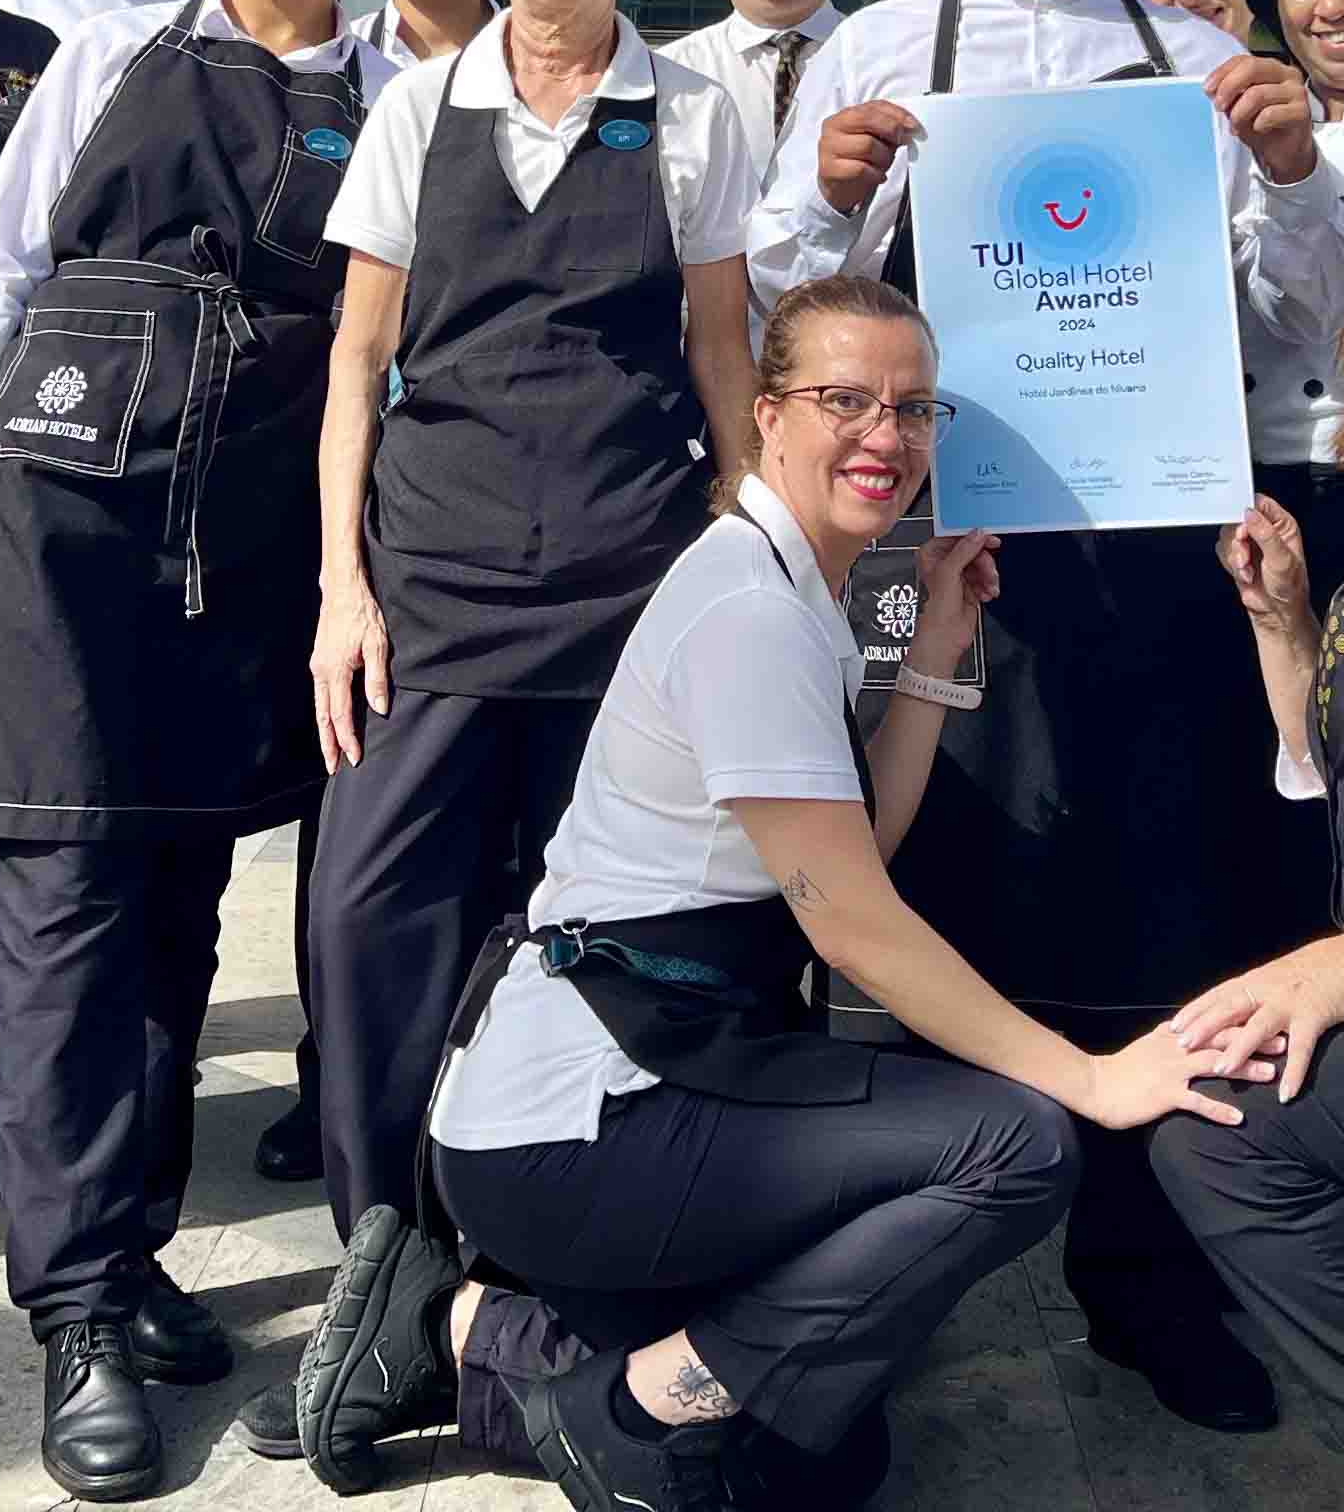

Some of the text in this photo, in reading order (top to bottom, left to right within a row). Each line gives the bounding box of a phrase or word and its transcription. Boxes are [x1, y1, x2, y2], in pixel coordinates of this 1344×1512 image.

[970, 241, 1024, 268] TUI
[993, 261, 1153, 290] Global Hotel
[1035, 286, 1139, 312] Awards
[1058, 318, 1096, 332] 2024
[1015, 347, 1145, 373] Quality Hotel
[3, 416, 98, 441] ADRIAN HOTELES
[863, 645, 902, 662] ADRIAN
